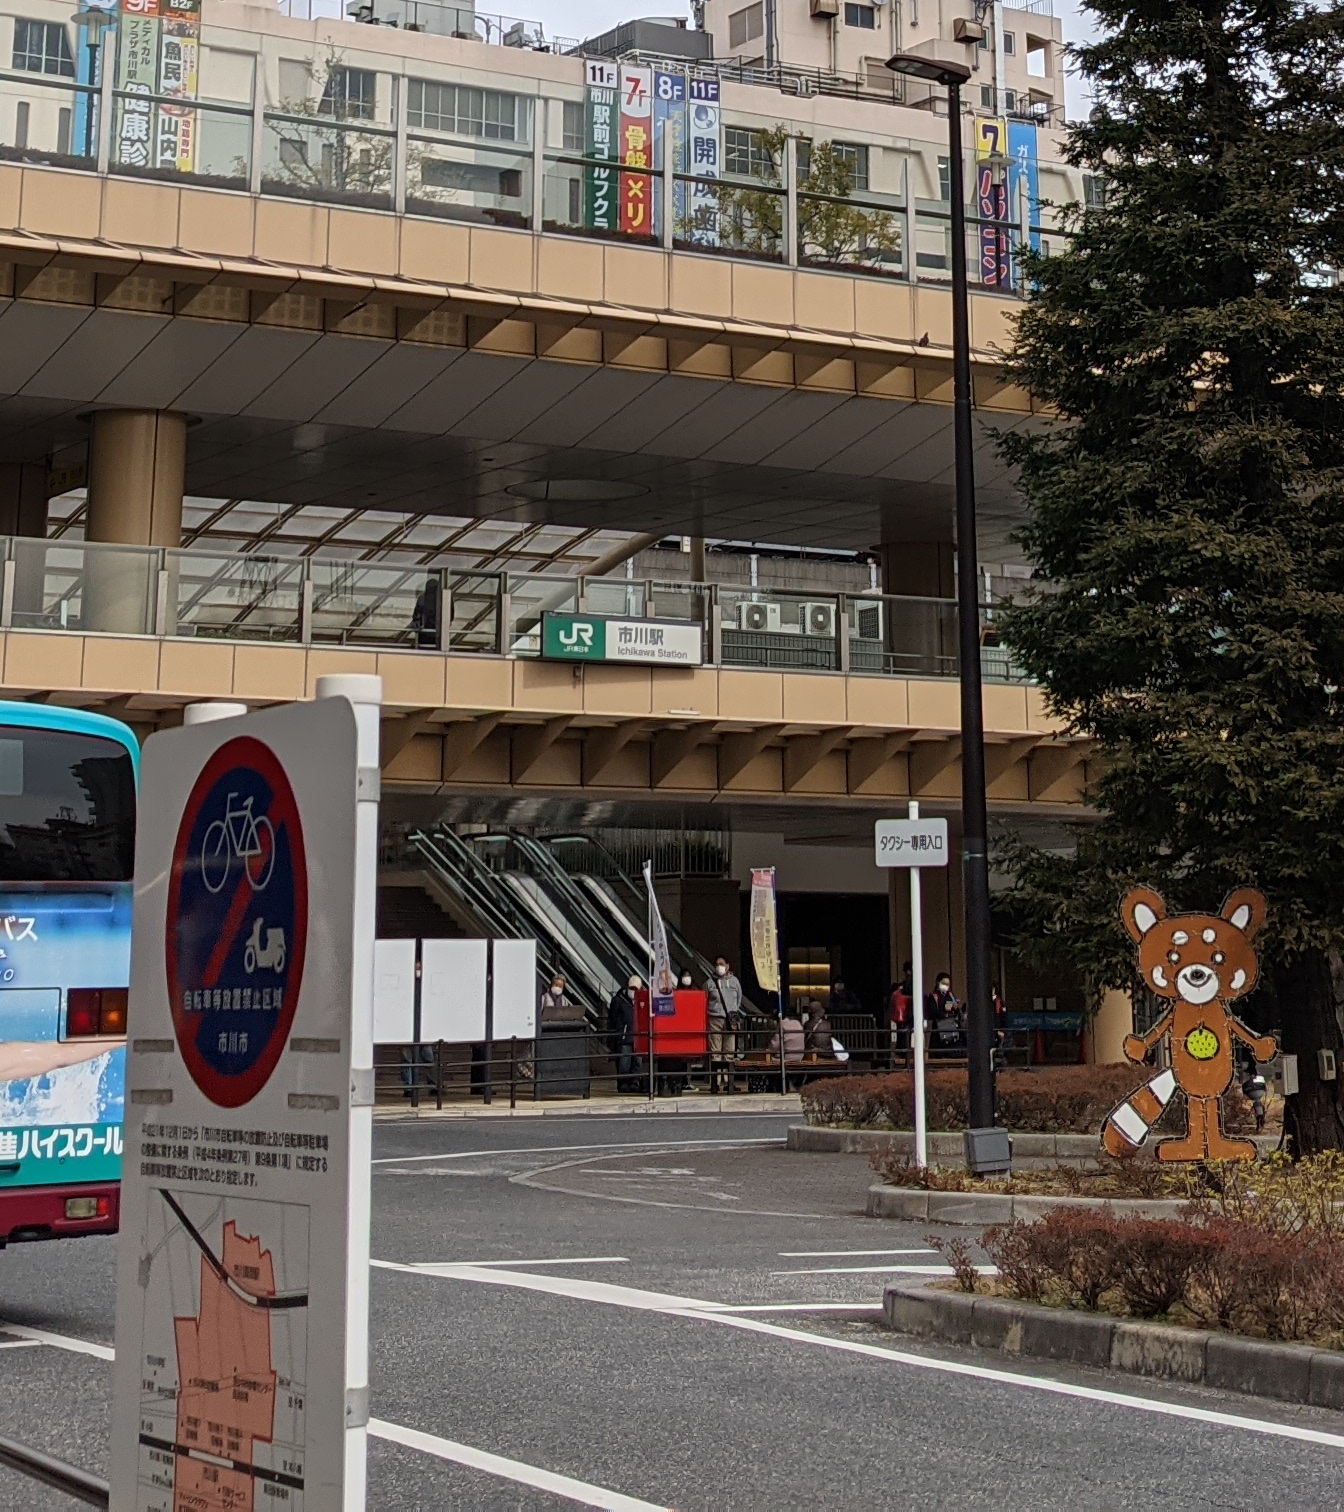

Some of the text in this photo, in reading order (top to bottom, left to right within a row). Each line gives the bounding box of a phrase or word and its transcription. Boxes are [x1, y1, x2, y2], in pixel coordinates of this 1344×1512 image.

[164, 41, 182, 82] 魚民
[589, 65, 614, 83] 11F
[626, 76, 647, 108] 7F
[659, 76, 682, 100] 8F
[691, 81, 718, 99] 11F
[559, 623, 593, 646] JR
[617, 626, 664, 646] 市川駅
[617, 646, 688, 660] Ichikawa Station
[880, 834, 943, 851] タクシー専用入口
[218, 1031, 248, 1053] 市川市
